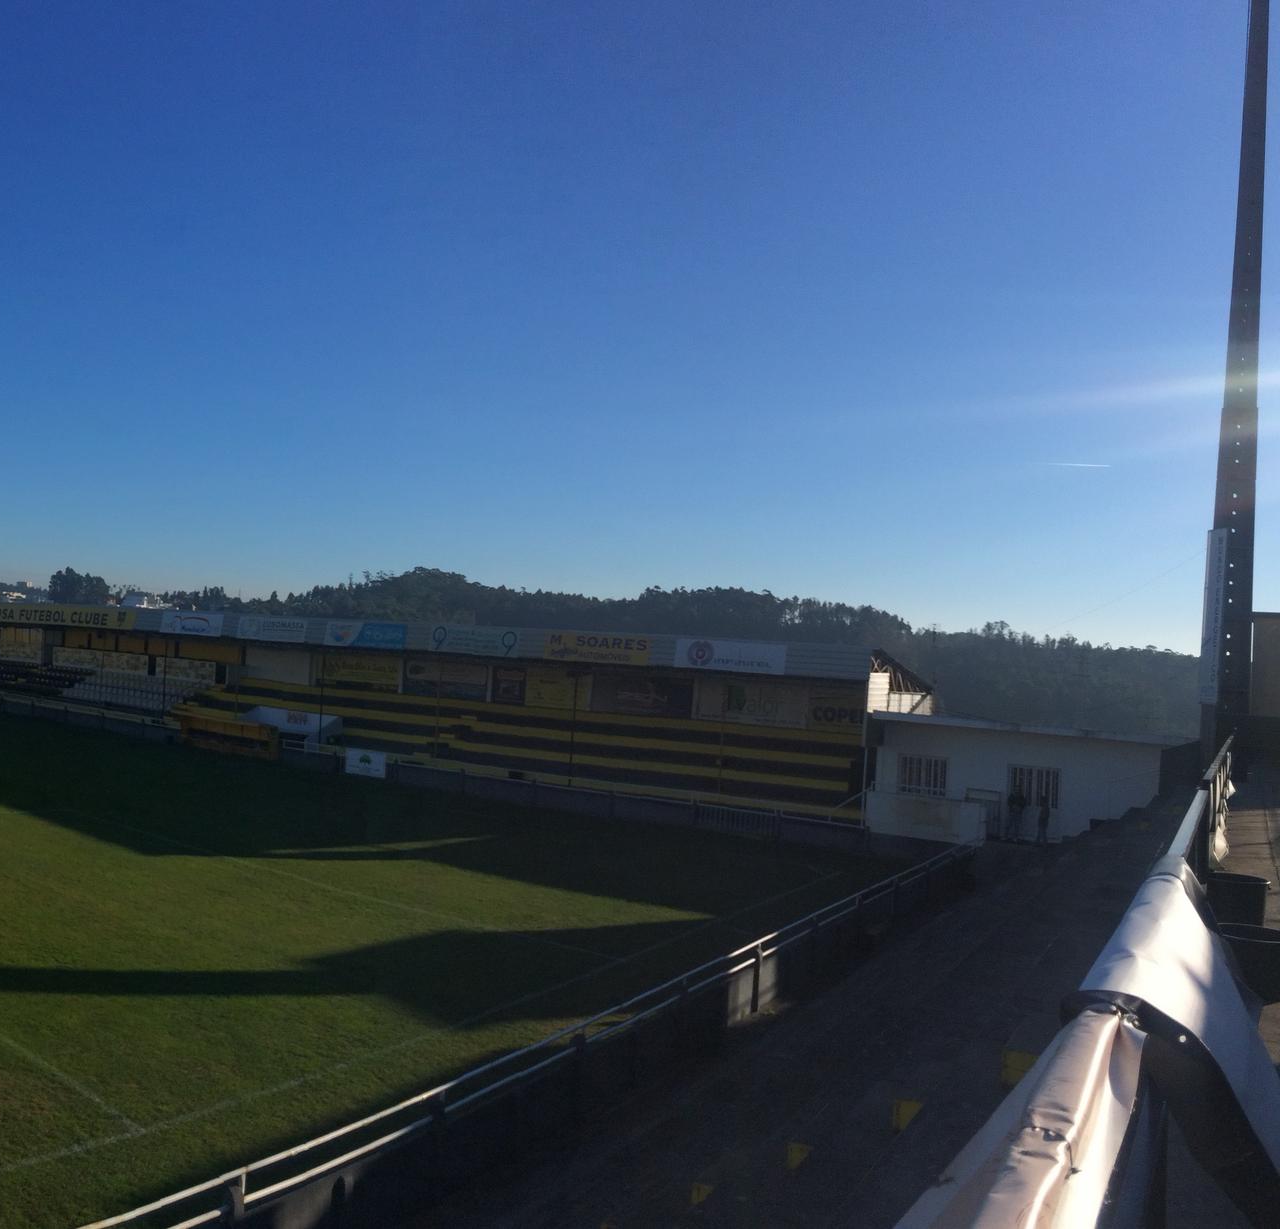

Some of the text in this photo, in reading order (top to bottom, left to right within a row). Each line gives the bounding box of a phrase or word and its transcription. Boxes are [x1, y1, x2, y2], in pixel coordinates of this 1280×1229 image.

[18, 609, 66, 622] FUTEBOL
[70, 612, 108, 625] CLUBE
[576, 635, 648, 651] SOARES
